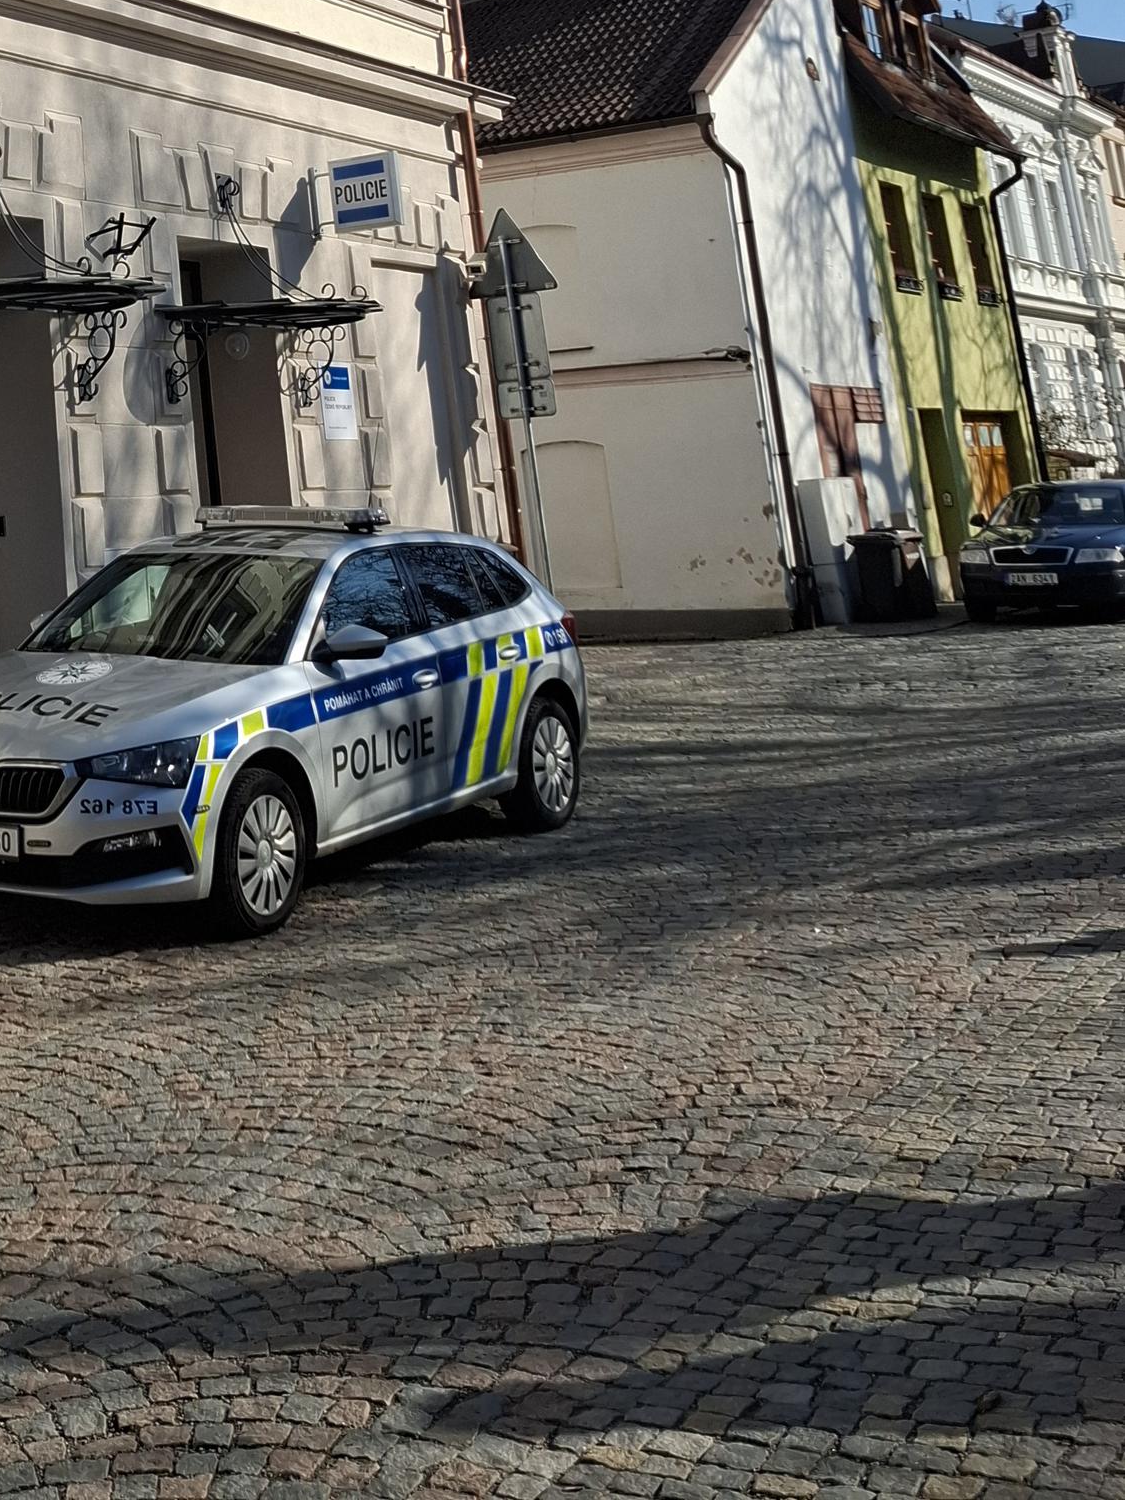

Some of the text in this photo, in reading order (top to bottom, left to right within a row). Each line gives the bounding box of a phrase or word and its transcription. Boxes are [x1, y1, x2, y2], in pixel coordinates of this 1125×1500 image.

[334, 179, 388, 205] POLICIE
[323, 677, 404, 712] POMÁHAT A CHRÁNIT
[332, 716, 435, 788] POLICIE
